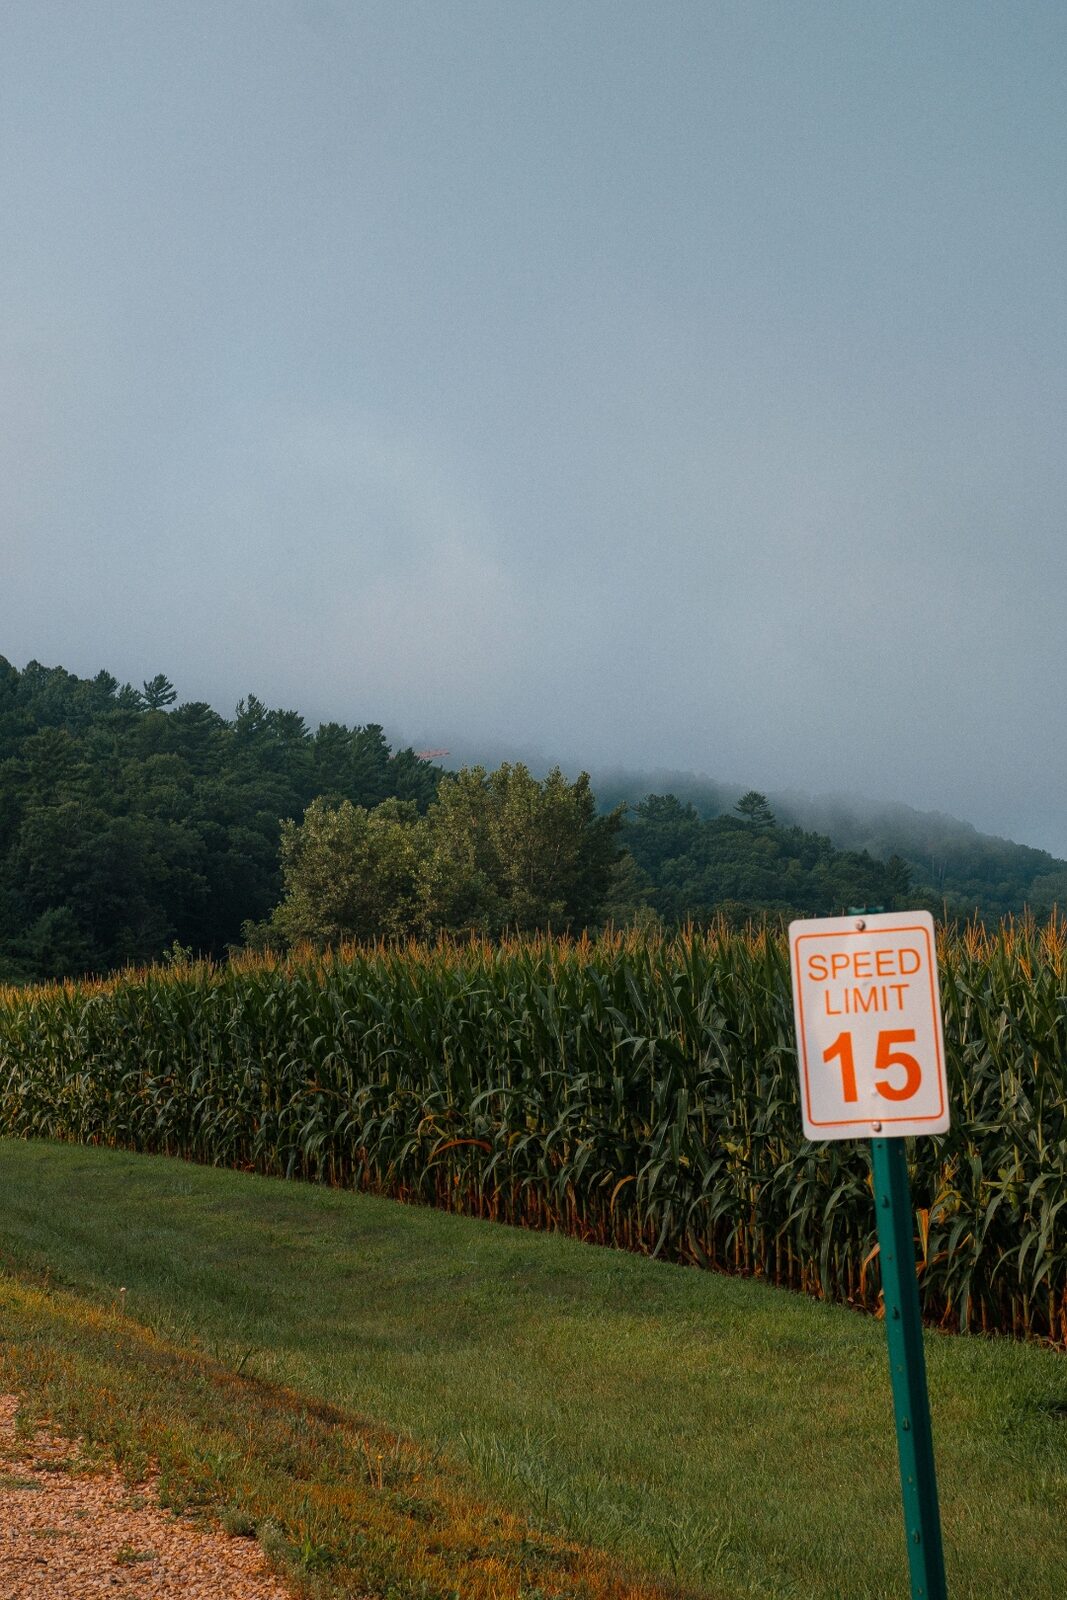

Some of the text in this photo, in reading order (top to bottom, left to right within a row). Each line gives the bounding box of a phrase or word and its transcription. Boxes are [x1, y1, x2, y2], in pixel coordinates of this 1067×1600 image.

[807, 948, 921, 982] SPEED
[824, 983, 910, 1016] LIMIT
[822, 1028, 923, 1103] 15
